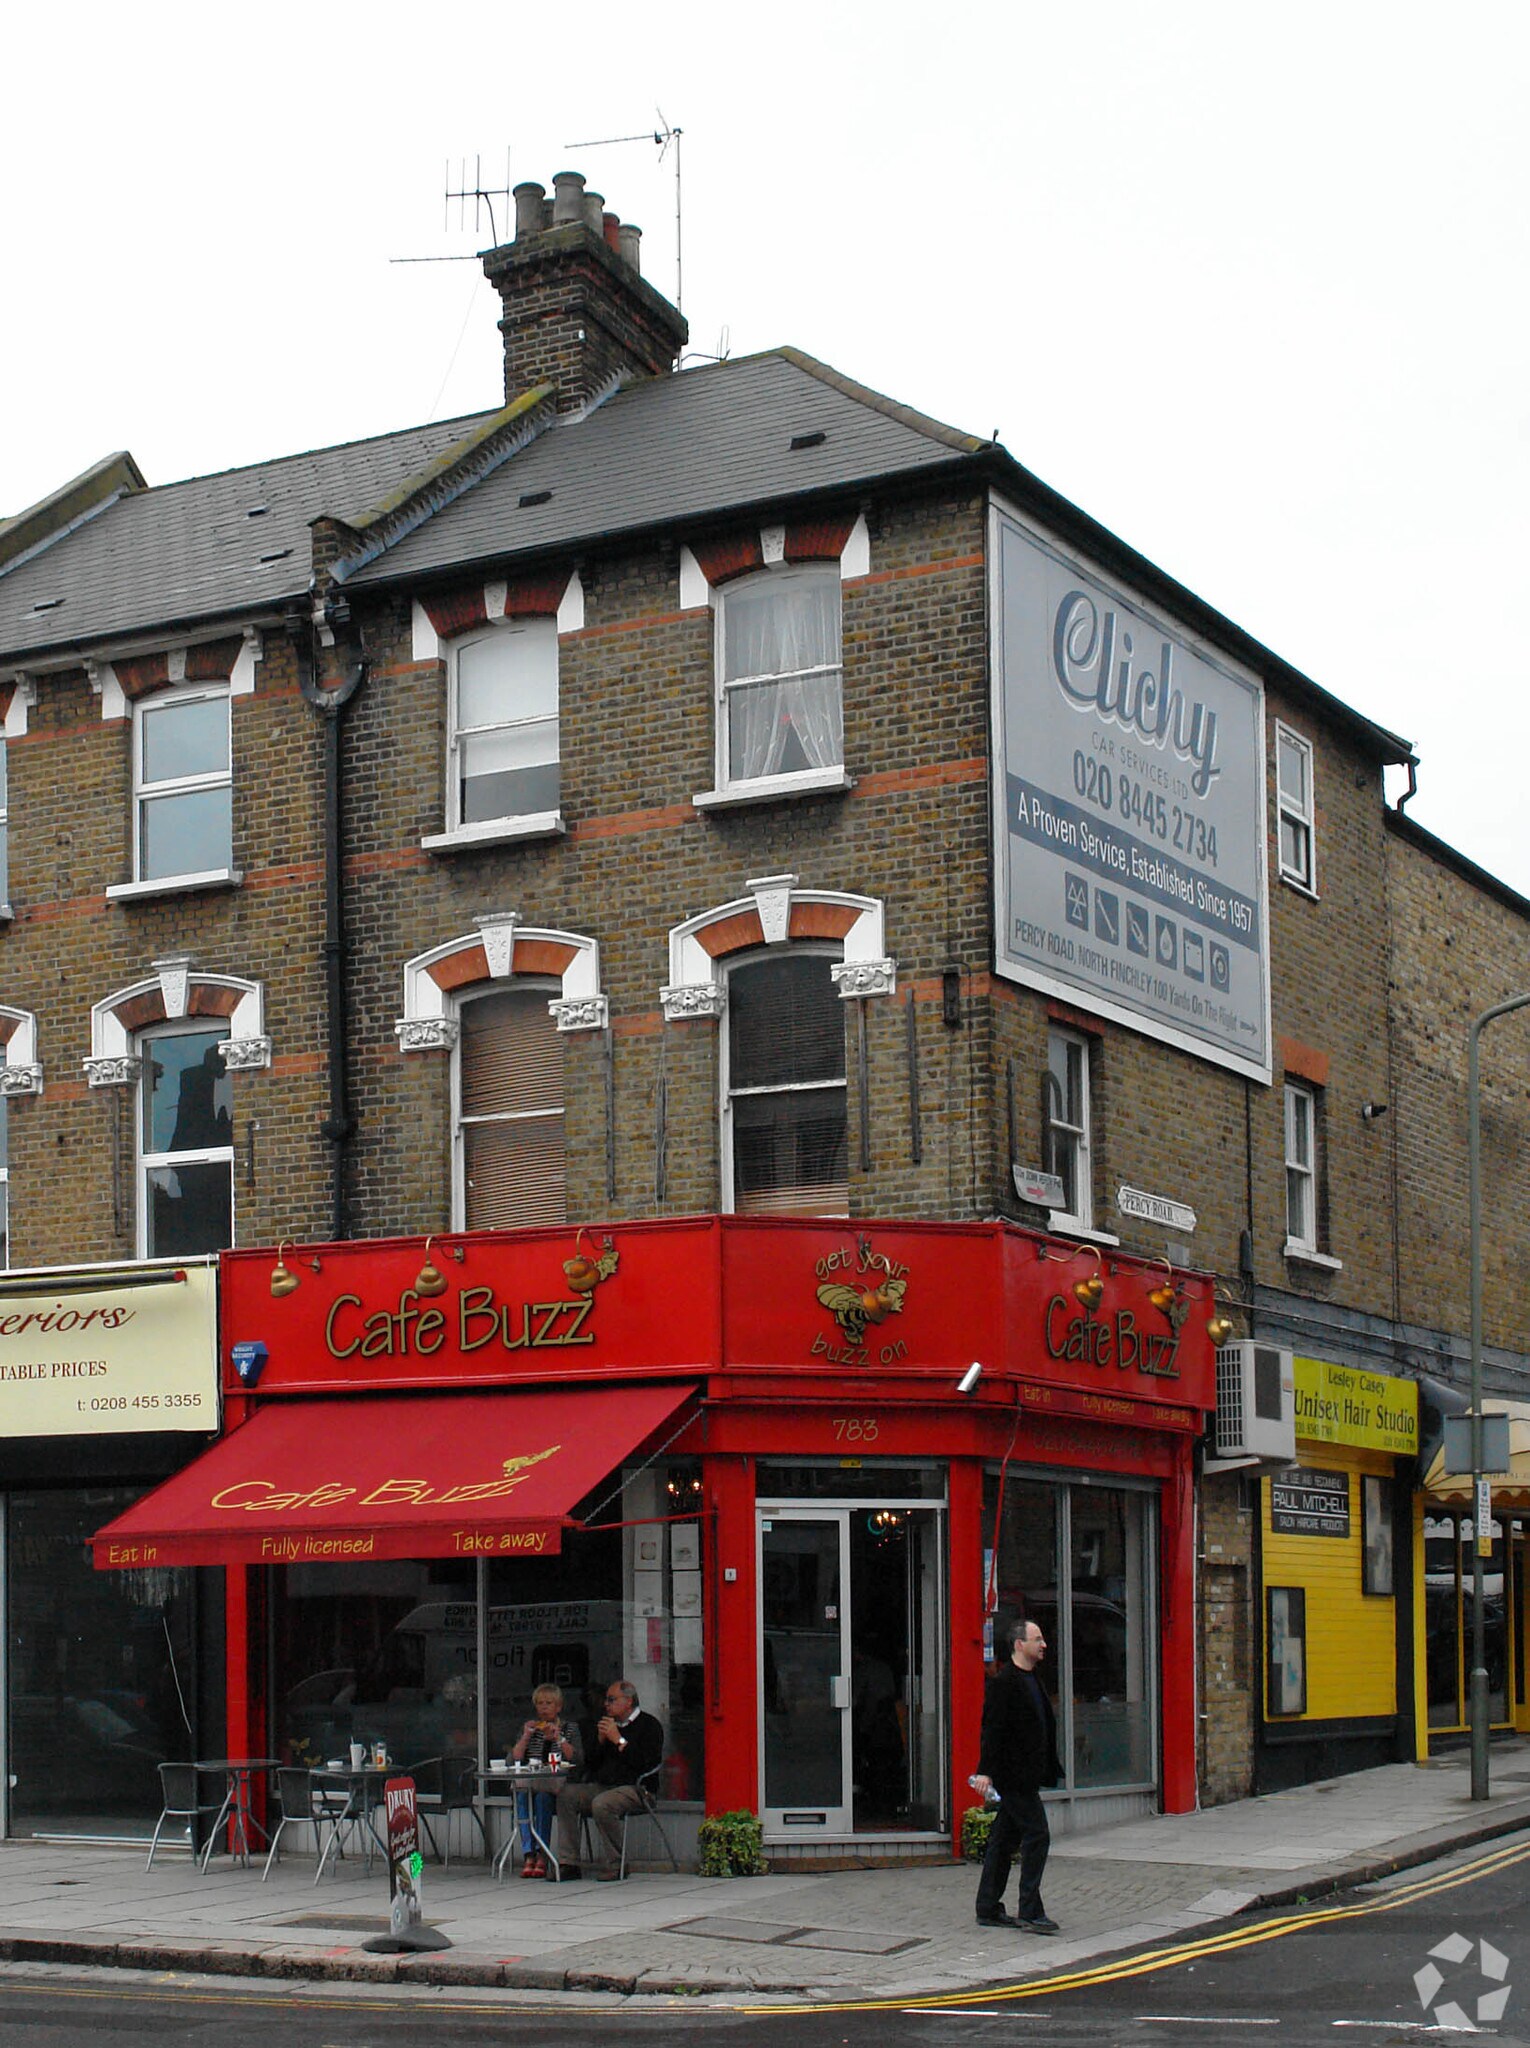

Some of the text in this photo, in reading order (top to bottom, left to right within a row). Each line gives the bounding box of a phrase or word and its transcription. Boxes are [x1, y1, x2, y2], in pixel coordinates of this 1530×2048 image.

[1054, 591, 1220, 798] Clichy
[1092, 732, 1189, 800] CAR SERVICES LTD
[1074, 749, 1218, 867] 020 8445 2734
[1018, 792, 1253, 933] A Proven Service, Established Since 1957
[1015, 918, 1238, 1032] PERCY ROAD, NORTH FINCHLEY 100 Yards On The Right
[1125, 1193, 1152, 1215] PERCY
[815, 1246, 911, 1281] get your
[326, 1287, 595, 1358] Cafe Buzz
[1046, 1295, 1181, 1378] Cafe Buzz
[810, 1332, 909, 1366] buzz on
[51, 1360, 108, 1379] PRICES
[1328, 1368, 1386, 1398] Lesley Casey
[77, 1394, 202, 1412] t: 0208 455 3355
[1024, 1384, 1040, 1401] Eat
[1294, 1389, 1415, 1435] Unisex Hair Studio
[832, 1419, 879, 1441] 783
[211, 1475, 530, 1511] Cafe Buzz
[1273, 1491, 1348, 1514] PAUL MITCHELL
[109, 1545, 141, 1563] Eat
[144, 1543, 157, 1562] in
[261, 1536, 300, 1560] Fully
[304, 1534, 374, 1555] licensed
[453, 1531, 496, 1551] Take
[499, 1532, 547, 1552] away
[387, 1787, 415, 1822] DRURY
